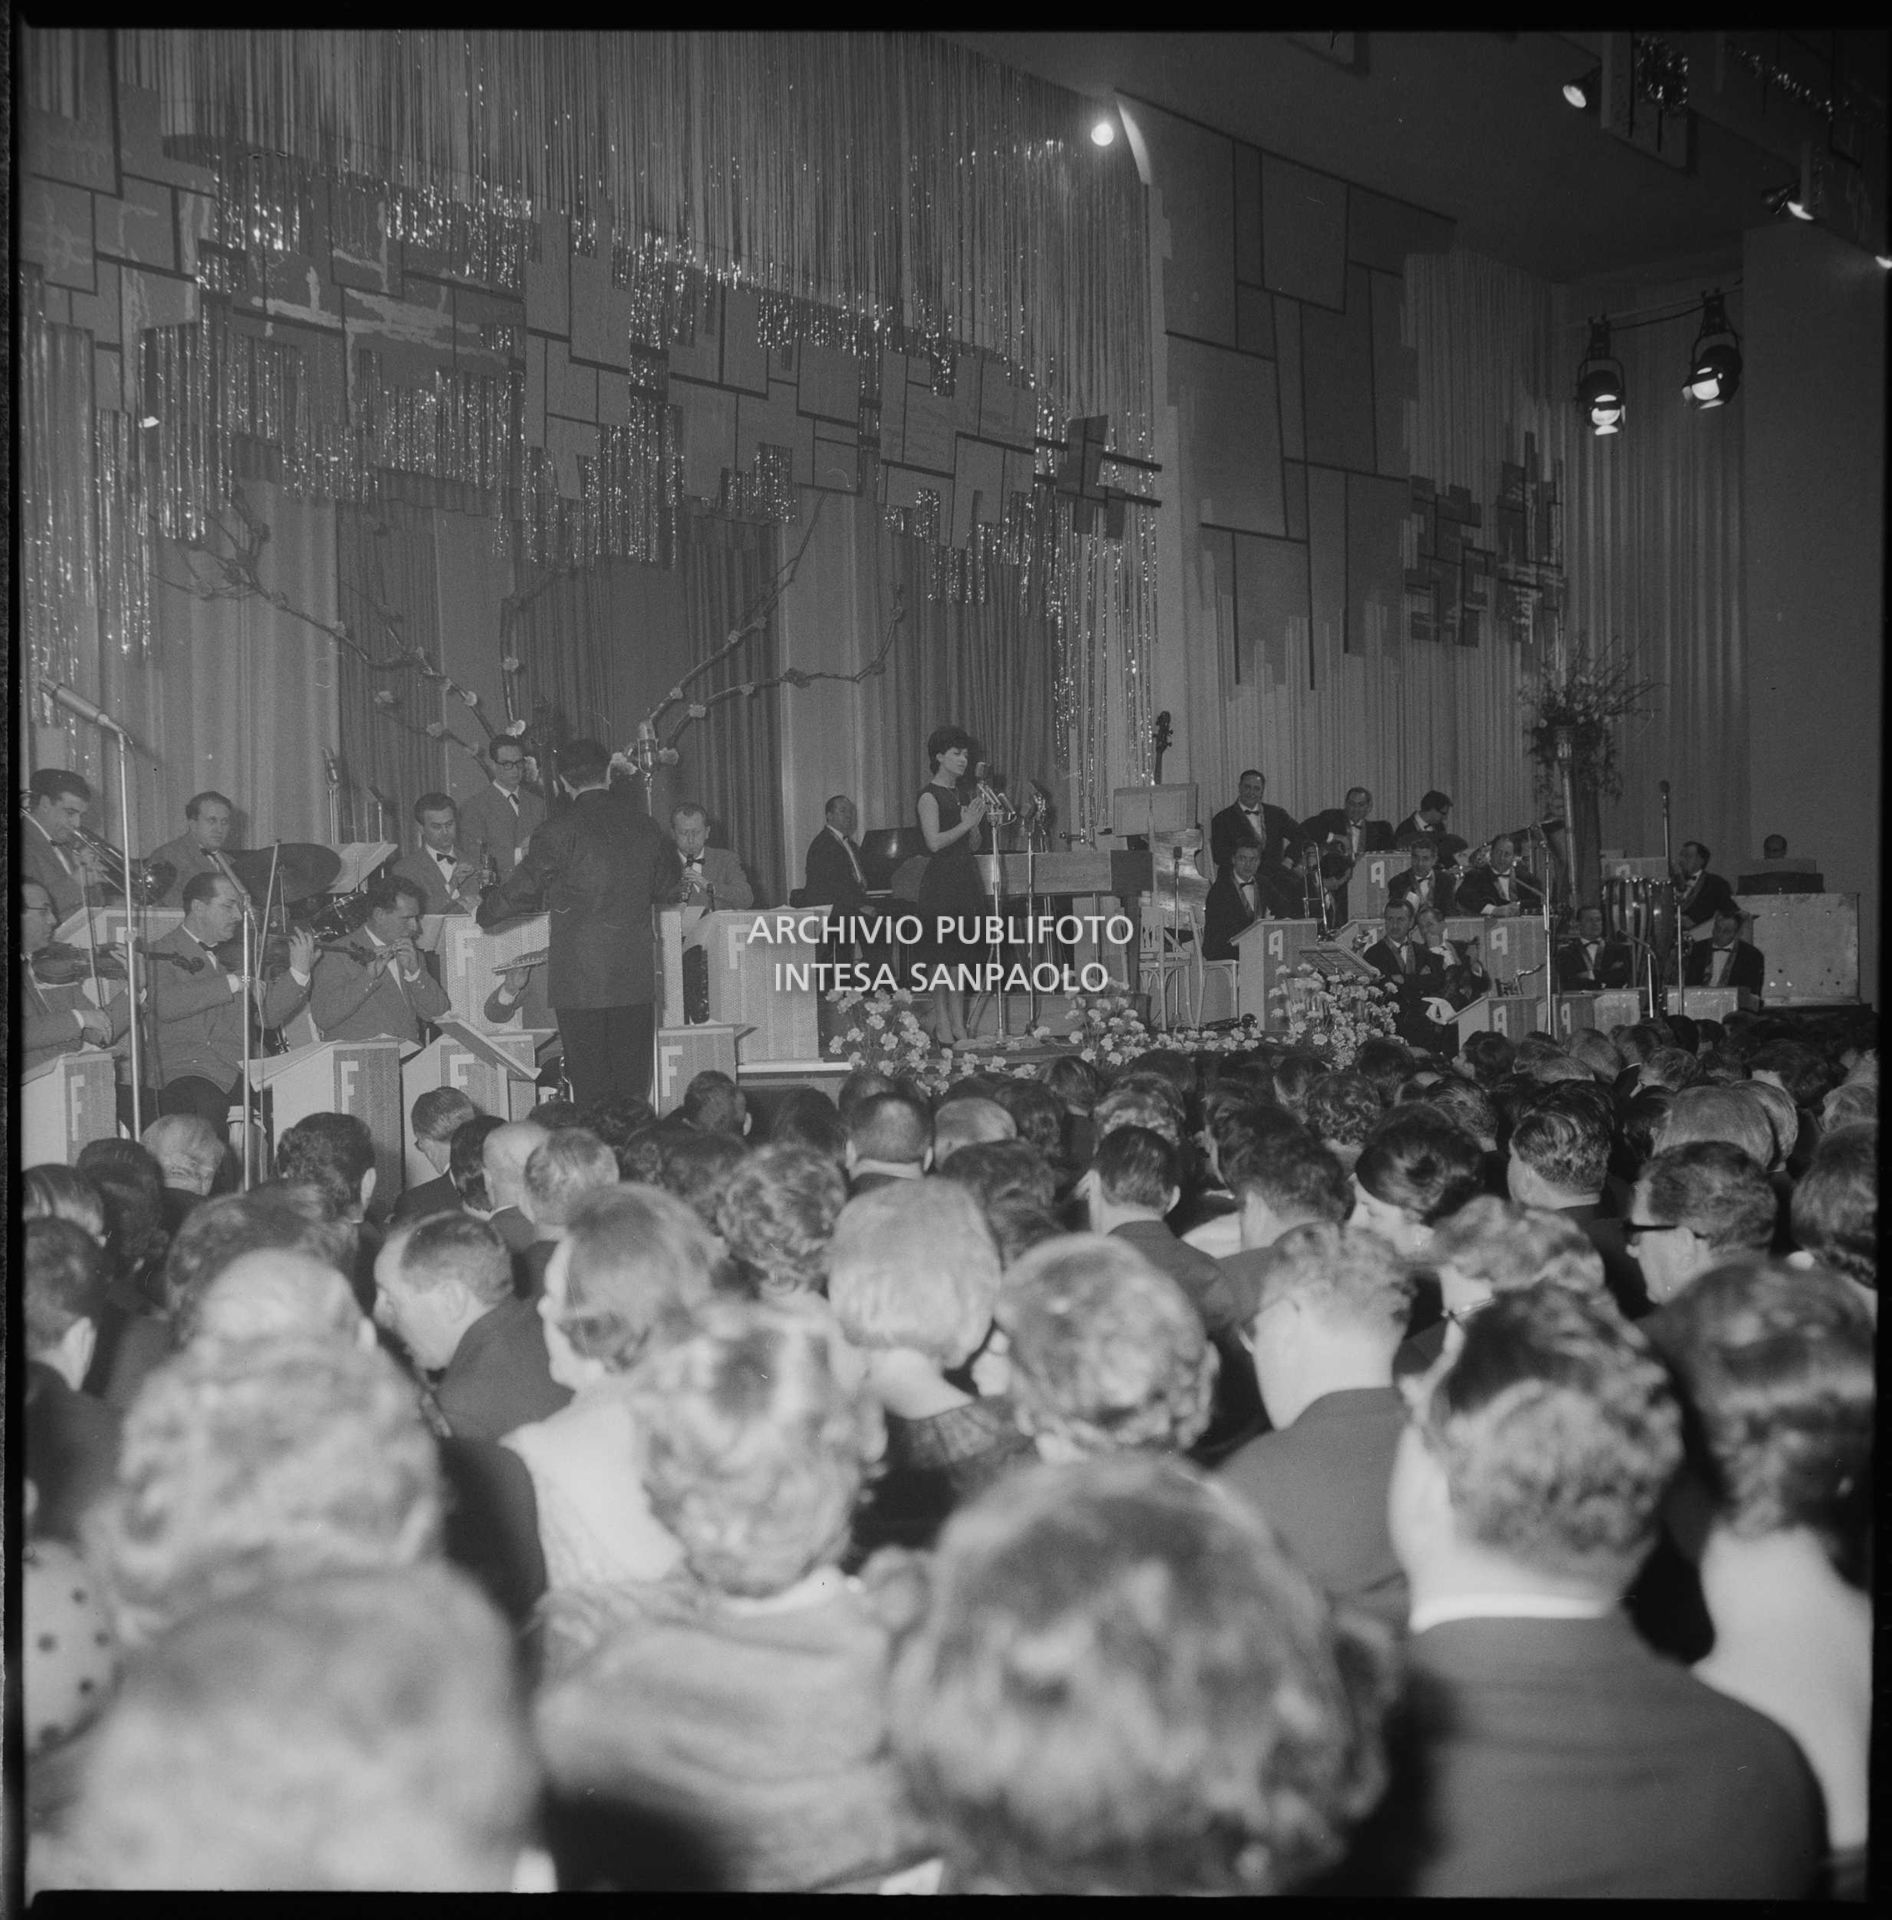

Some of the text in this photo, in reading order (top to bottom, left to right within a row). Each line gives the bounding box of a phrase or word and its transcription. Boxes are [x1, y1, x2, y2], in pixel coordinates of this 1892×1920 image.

[455, 929, 482, 977] F
[728, 924, 751, 970] F
[340, 1061, 359, 1114] F
[449, 1054, 475, 1090] F
[660, 1045, 683, 1097] F
[70, 1074, 85, 1141] F
